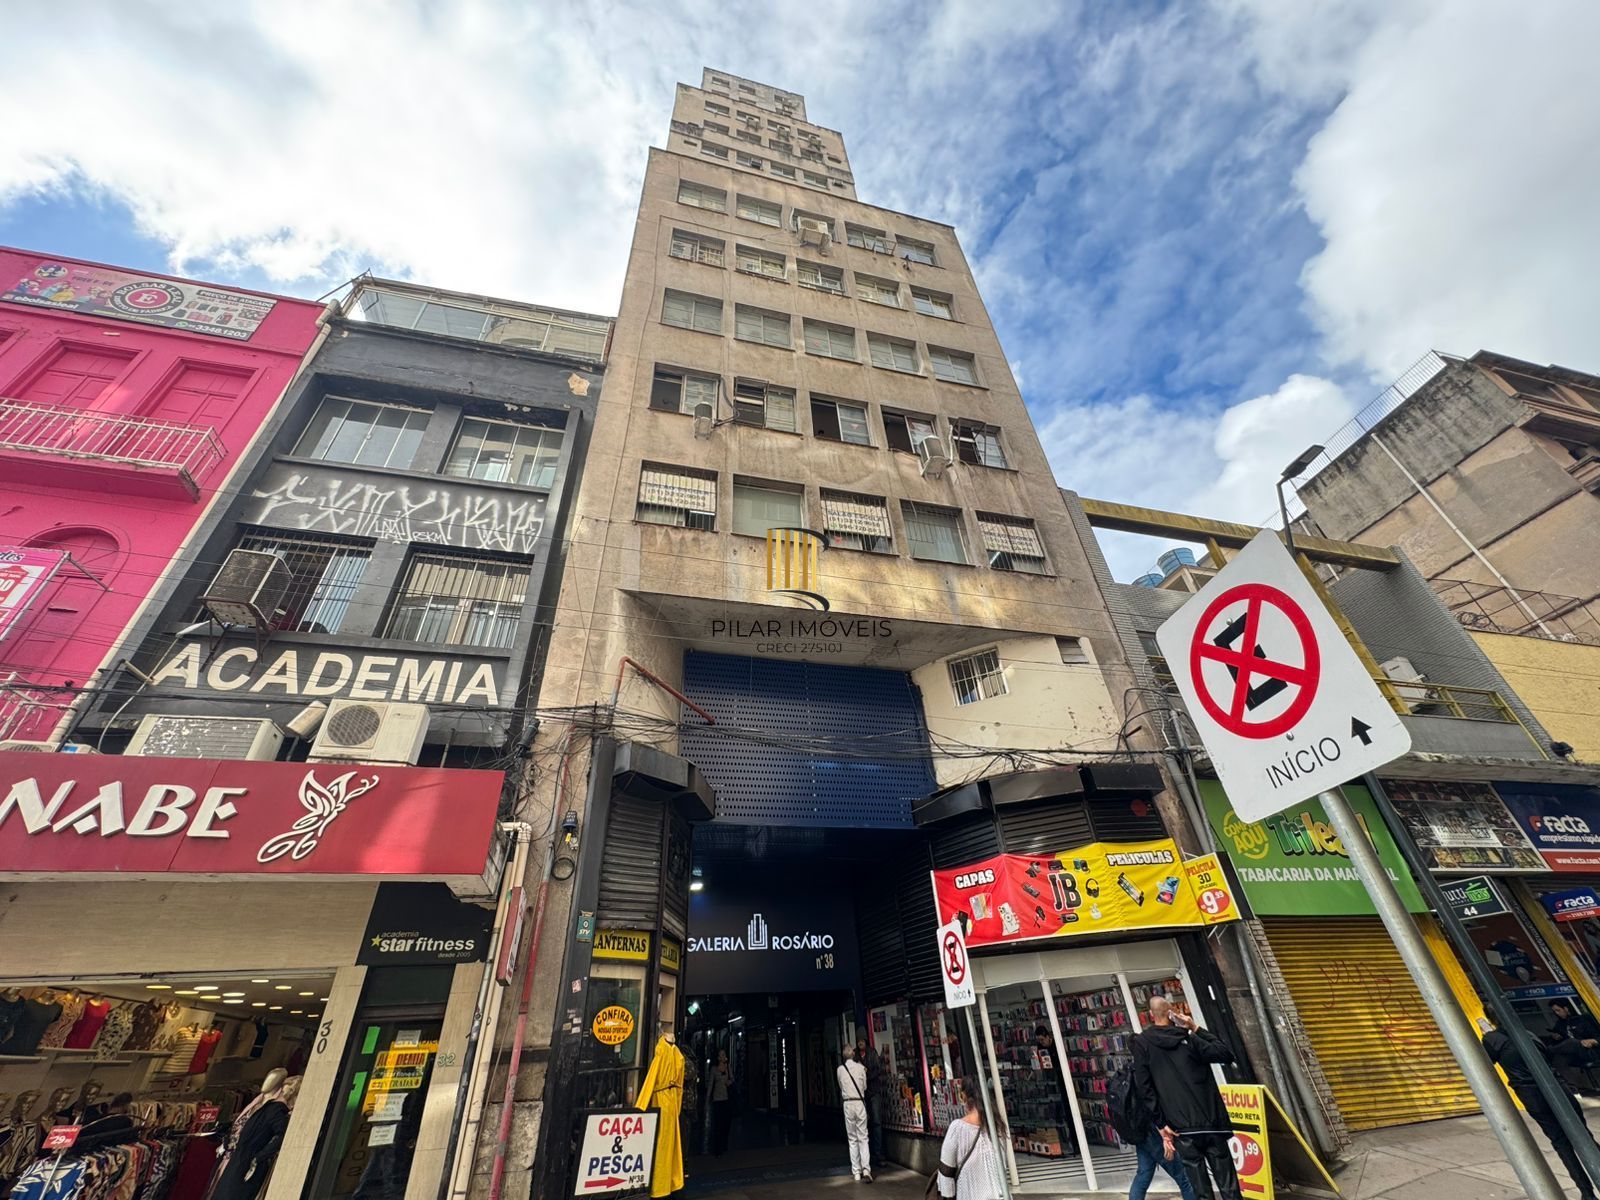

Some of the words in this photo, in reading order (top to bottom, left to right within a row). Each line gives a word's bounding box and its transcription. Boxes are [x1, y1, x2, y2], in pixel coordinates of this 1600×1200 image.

[116, 282, 167, 295] BOLSAS
[167, 286, 183, 304] LEAL
[241, 297, 273, 308] ATACADO
[151, 643, 499, 705] ACADEMIA
[1265, 736, 1341, 789] INÍCIO
[1542, 814, 1591, 833] facta
[1233, 824, 1269, 855] AQUI
[1186, 860, 1217, 877] PELÍCULA
[1197, 872, 1212, 884] 3D
[1238, 867, 1314, 882] TABACARIA
[1315, 867, 1334, 881] DA
[954, 869, 996, 889] CAPAS
[1048, 872, 1082, 911] JB
[1463, 906, 1478, 916] 44
[1563, 895, 1595, 908] facta
[381, 930, 420, 938] academia
[687, 936, 745, 952] GALERIA
[772, 930, 835, 951] ROSÁRIO
[596, 1007, 633, 1026] CONFIRA!
[438, 1053, 455, 1068] 32
[1221, 1090, 1259, 1109] ELÍCULA
[1245, 1112, 1261, 1121] RETA
[598, 1116, 644, 1140] CAÇA
[611, 1136, 624, 1154] &
[587, 1153, 644, 1177] PESCA
